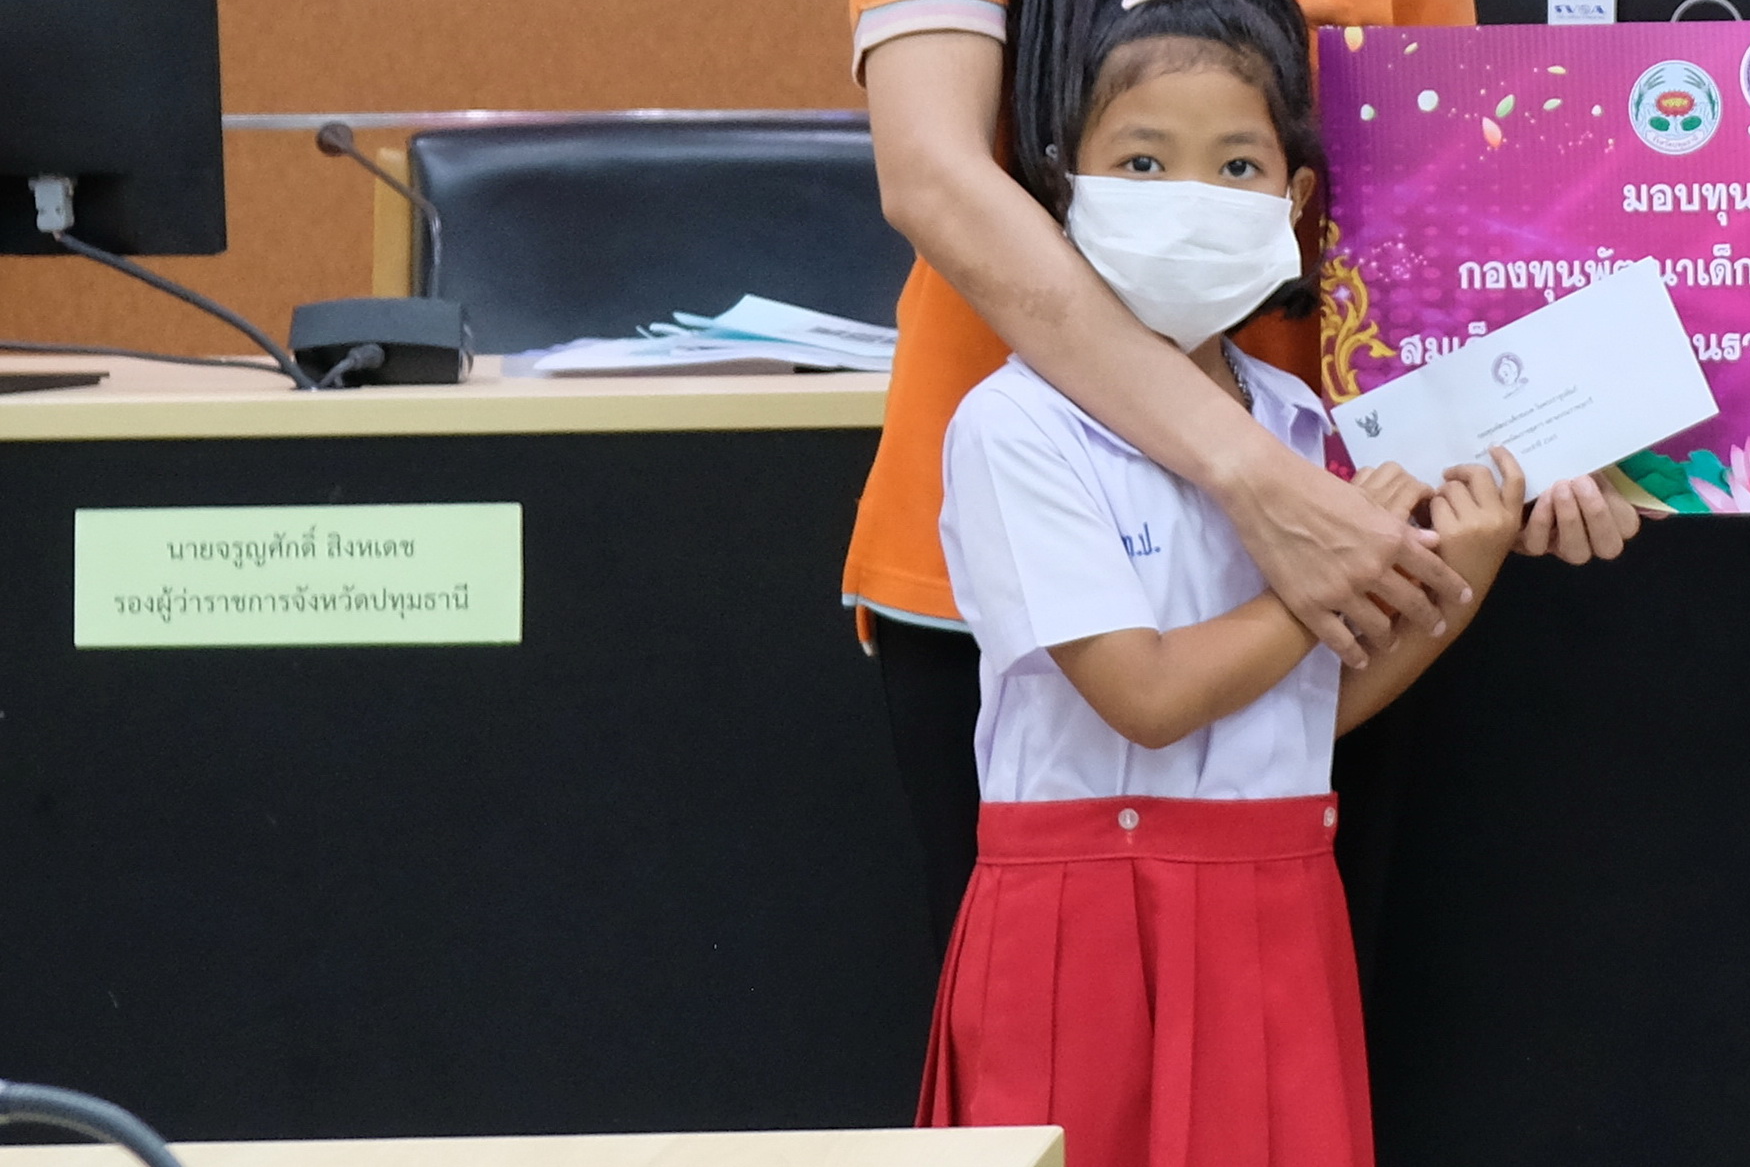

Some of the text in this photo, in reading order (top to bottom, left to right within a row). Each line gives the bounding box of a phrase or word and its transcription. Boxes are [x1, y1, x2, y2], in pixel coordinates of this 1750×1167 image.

[114, 583, 471, 622] รองผู้ว่าราชการจังหวัดปทุมธานี
